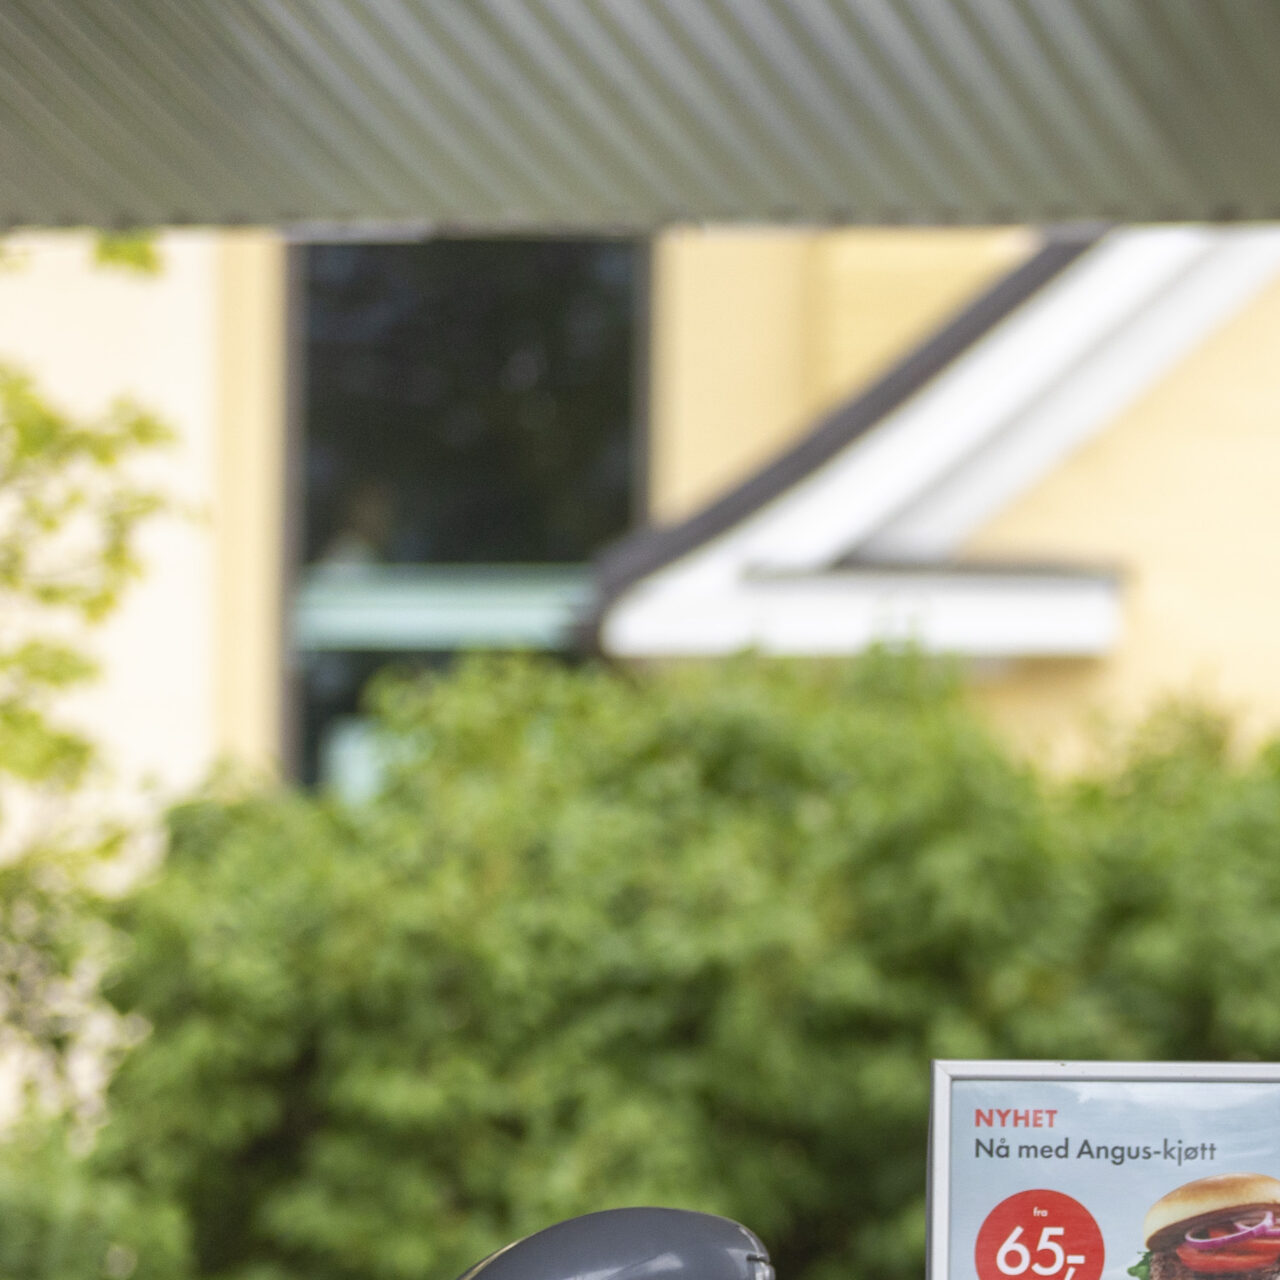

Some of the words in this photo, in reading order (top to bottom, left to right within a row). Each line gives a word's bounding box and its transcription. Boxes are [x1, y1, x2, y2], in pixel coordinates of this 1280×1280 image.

[974, 1109, 1058, 1128] NYHET
[975, 1137, 1010, 1159] Nå
[1018, 1137, 1069, 1159] med
[1076, 1138, 1217, 1166] Angus-kjøtt
[1033, 1206, 1048, 1217] fra
